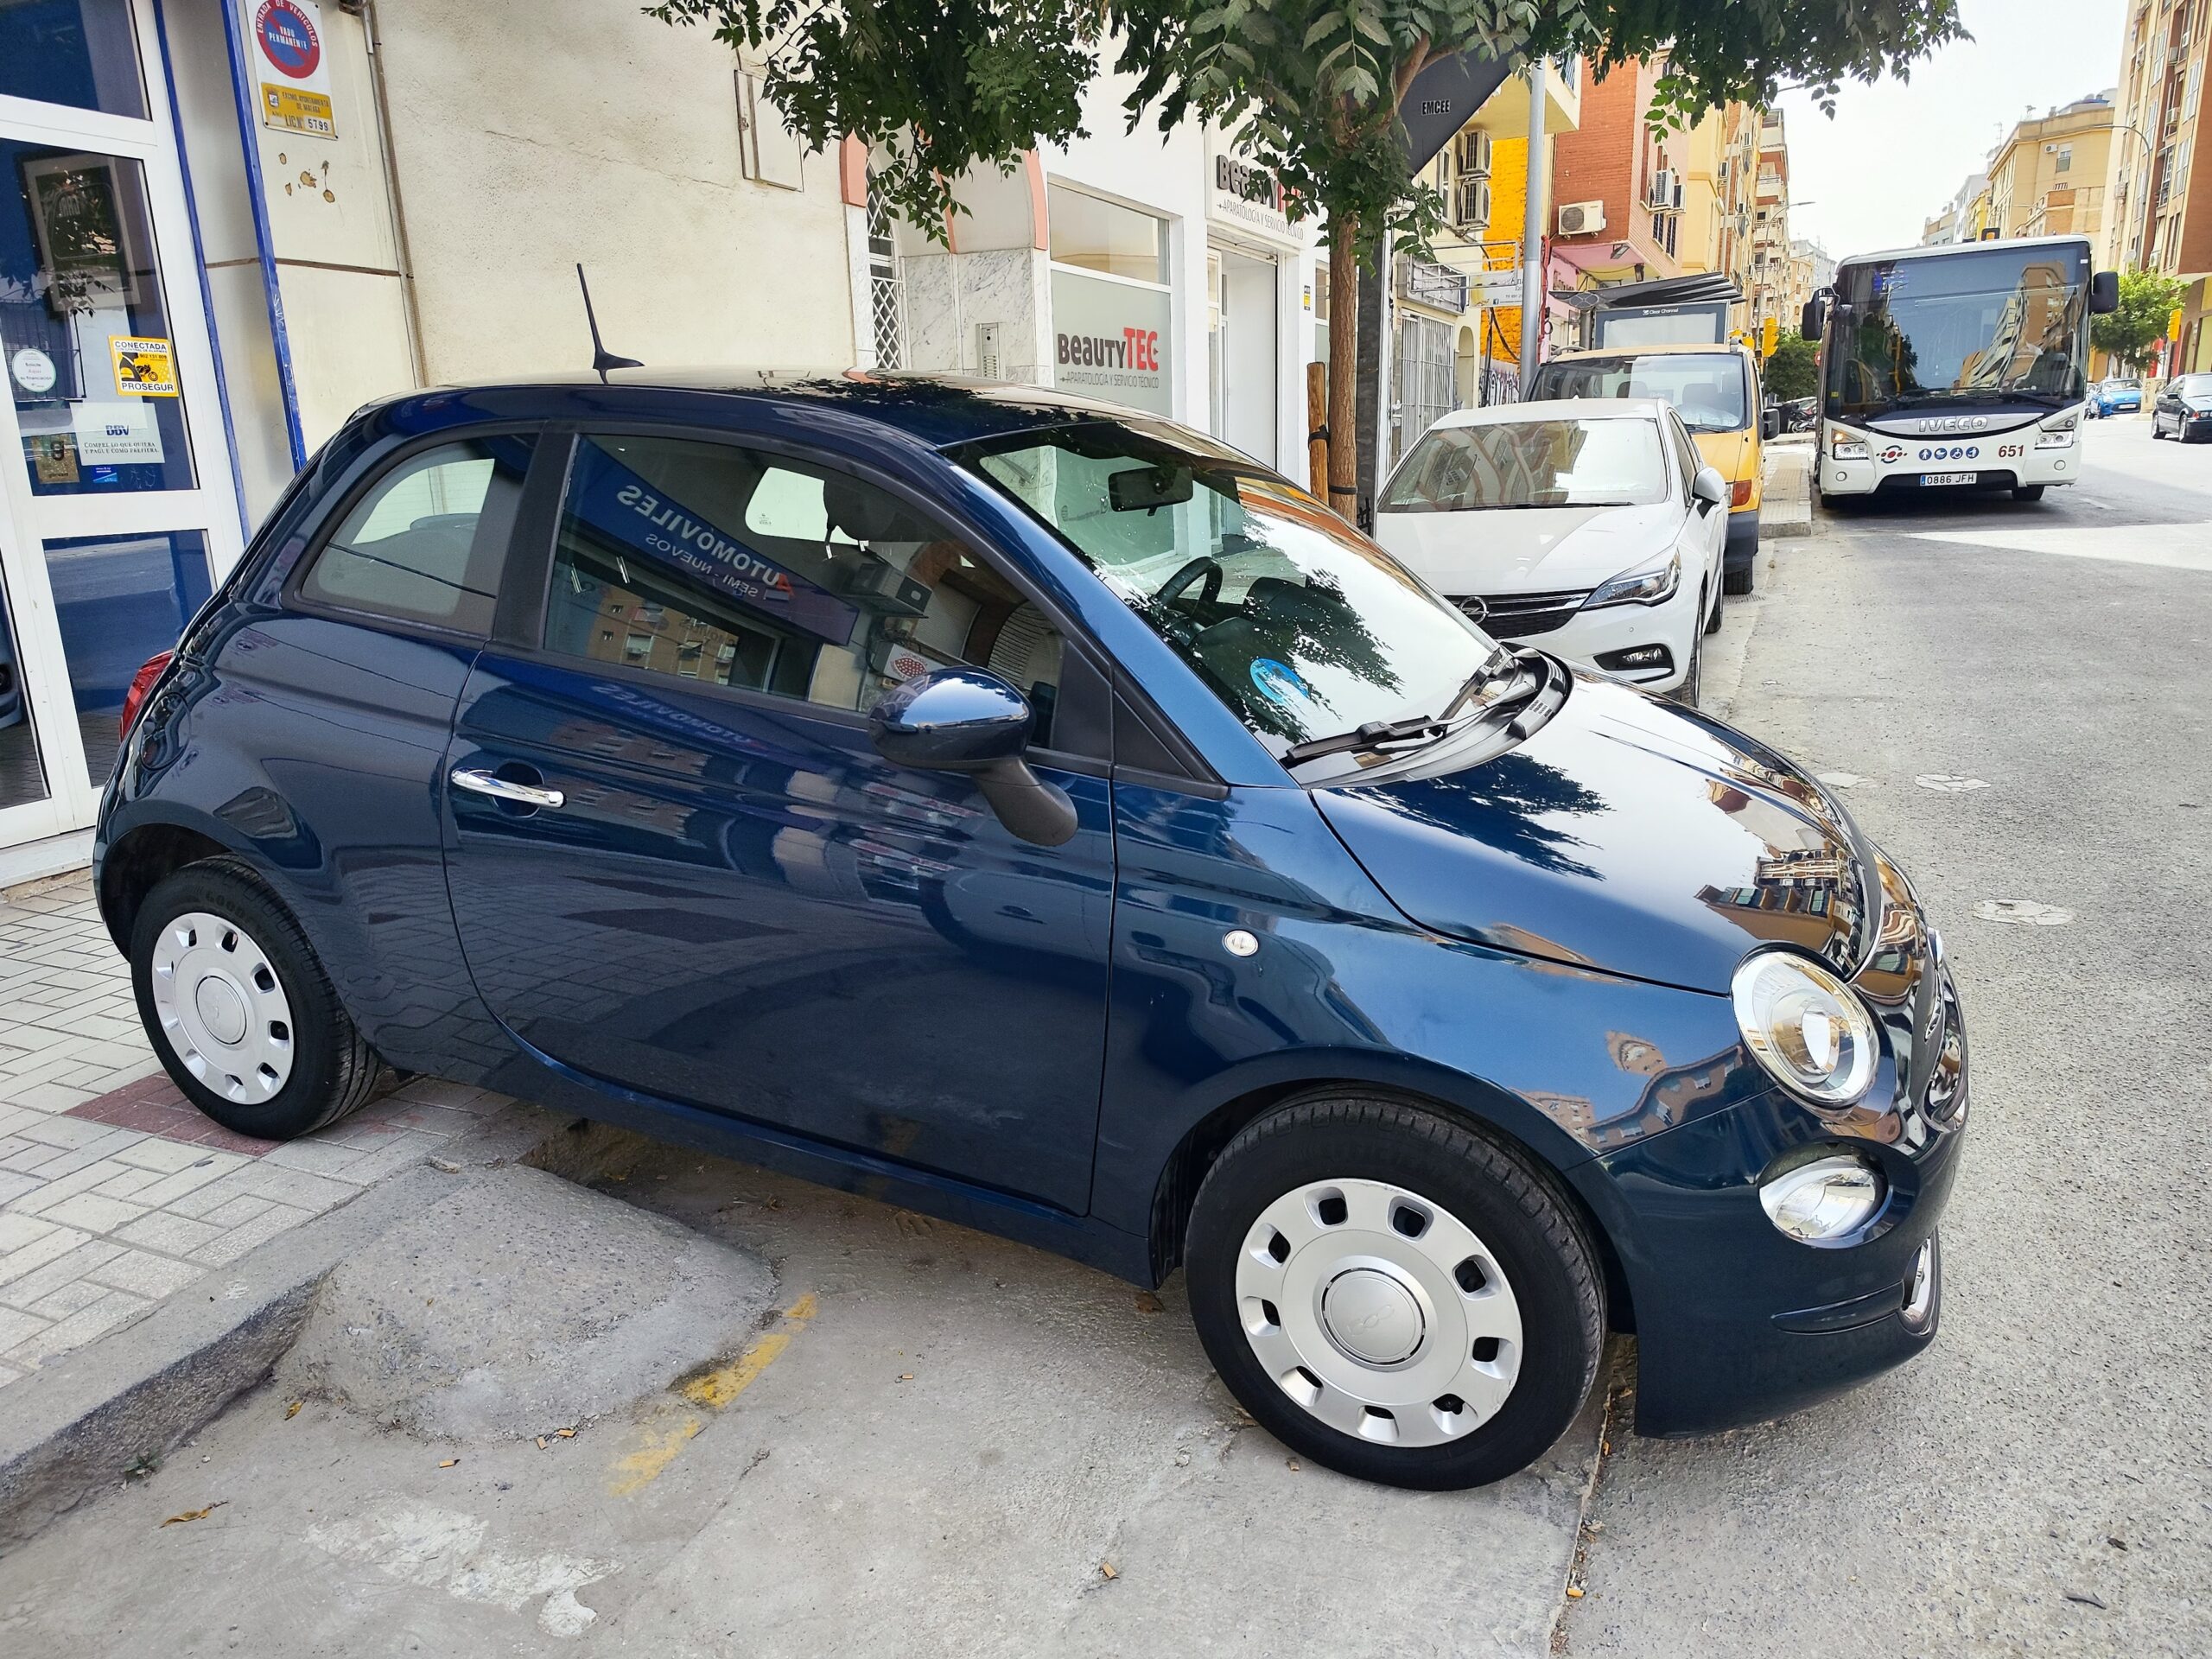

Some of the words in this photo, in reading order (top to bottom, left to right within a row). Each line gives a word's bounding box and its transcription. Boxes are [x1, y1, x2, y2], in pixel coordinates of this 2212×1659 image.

[257, 2, 271, 34] ENTRADA
[279, 26, 295, 37] VADO
[268, 32, 308, 50] PERMANENTE
[1422, 99, 1450, 115] EMCEE
[115, 341, 166, 350] CONECTADA
[1067, 372, 1109, 386] APARATOLOGÍA
[1114, 374, 1137, 388] SERVICIO
[1919, 416, 1987, 432] IVECO
[1998, 445, 2024, 458] 651
[1927, 475, 1952, 485] 0886
[1955, 474, 1974, 484] JFH
